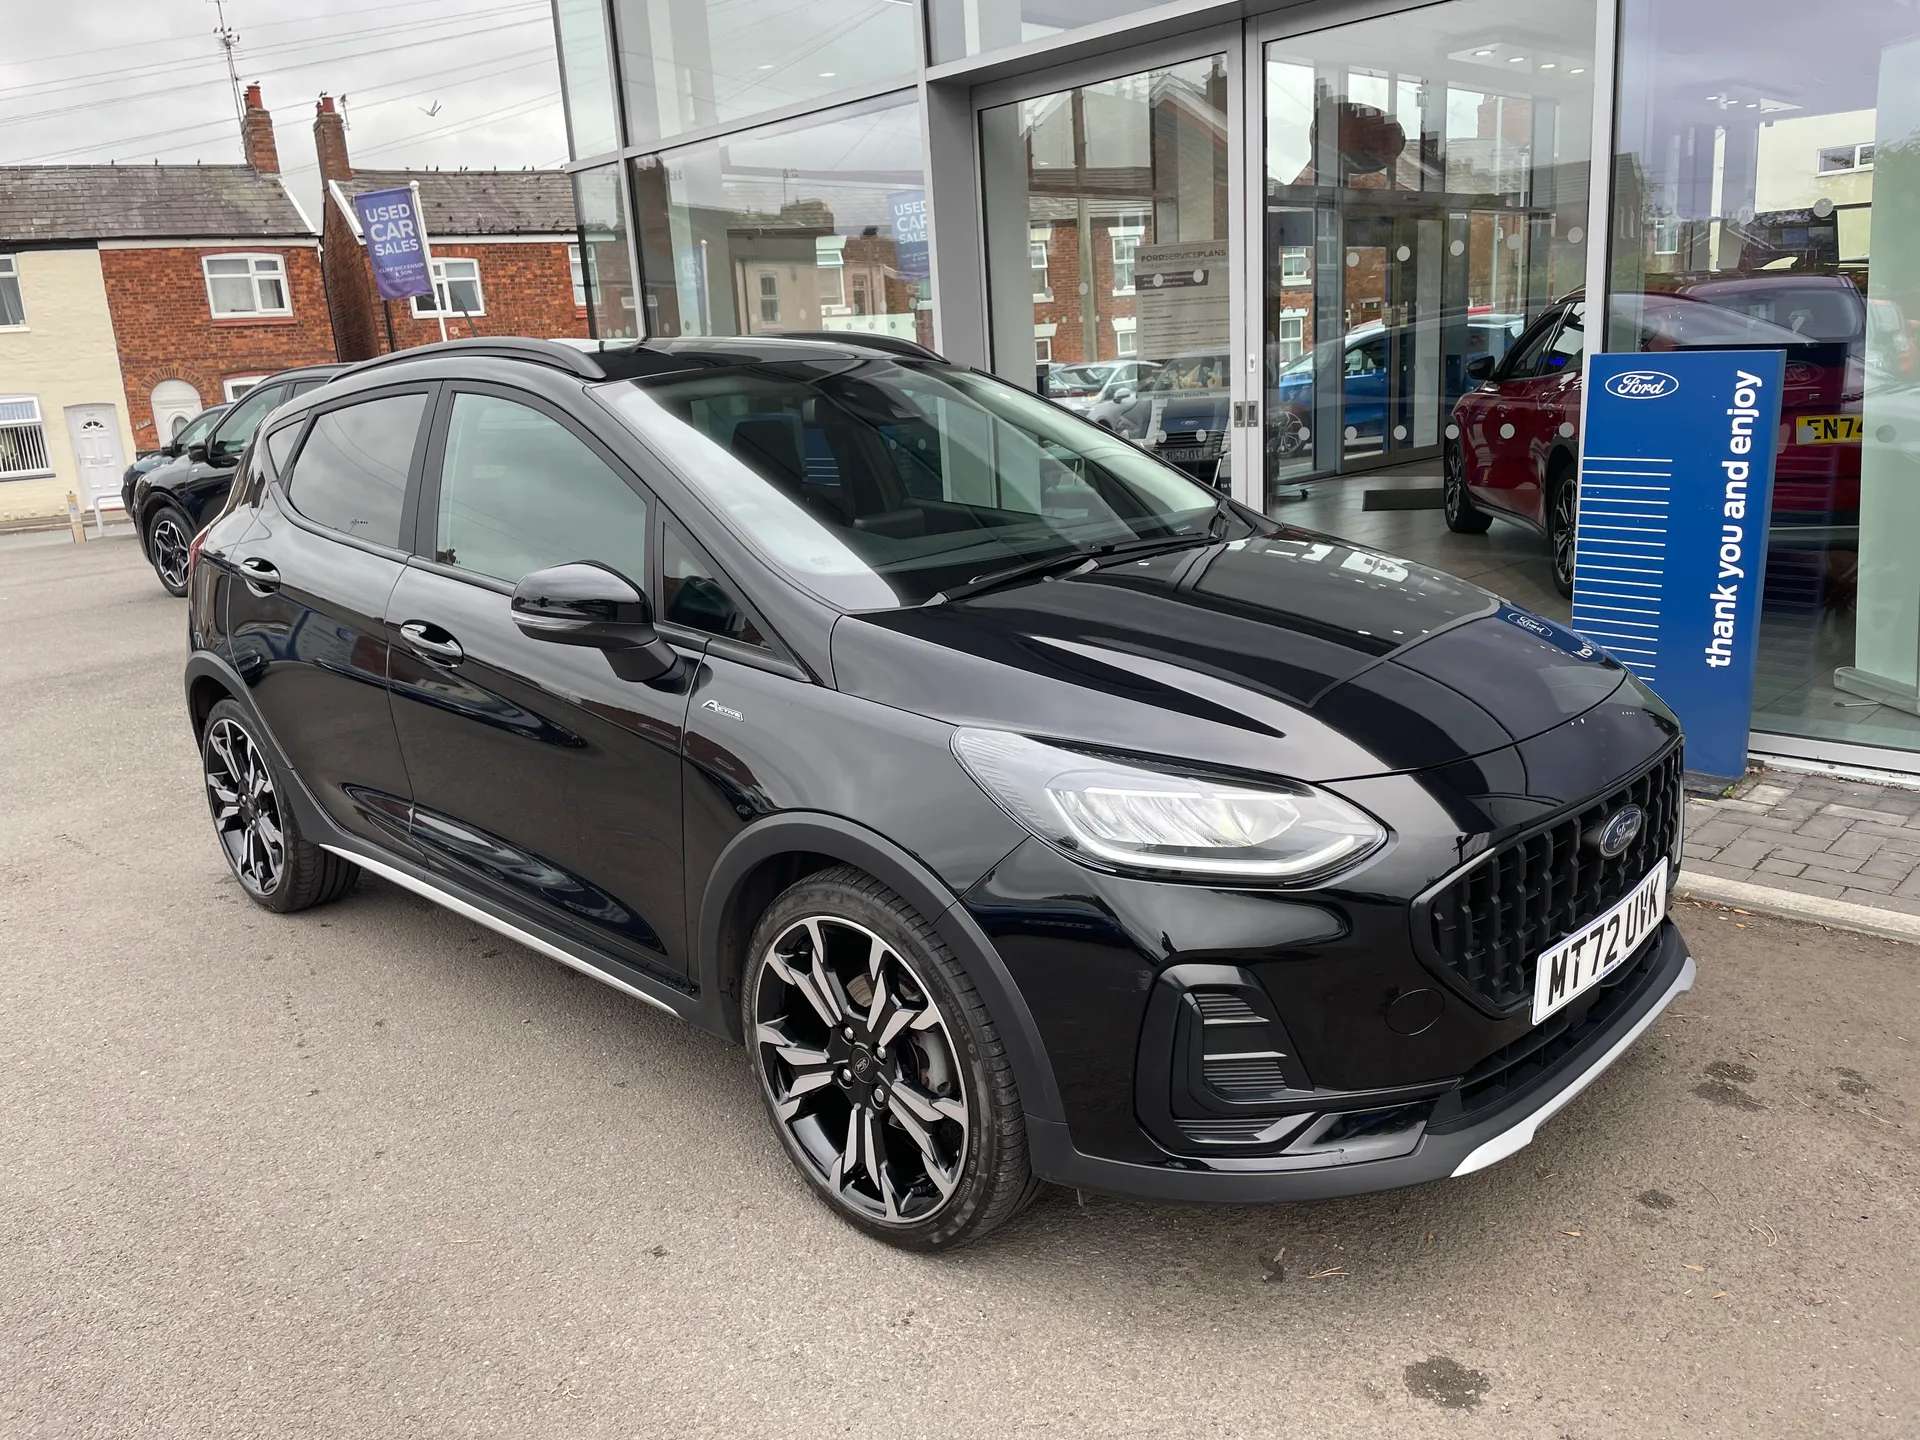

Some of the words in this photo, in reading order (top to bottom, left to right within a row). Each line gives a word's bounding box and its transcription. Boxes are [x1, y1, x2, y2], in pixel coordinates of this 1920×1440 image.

[366, 204, 410, 223] USED
[370, 220, 415, 242] CAR
[375, 239, 418, 256] SALES
[1617, 374, 1666, 395] Ford
[1727, 369, 1763, 455] enjoy
[1721, 460, 1750, 520] and
[1718, 524, 1745, 579] you
[1704, 583, 1738, 668] thank
[1547, 913, 1621, 1007] MT72
[1624, 871, 1661, 948] UVK
